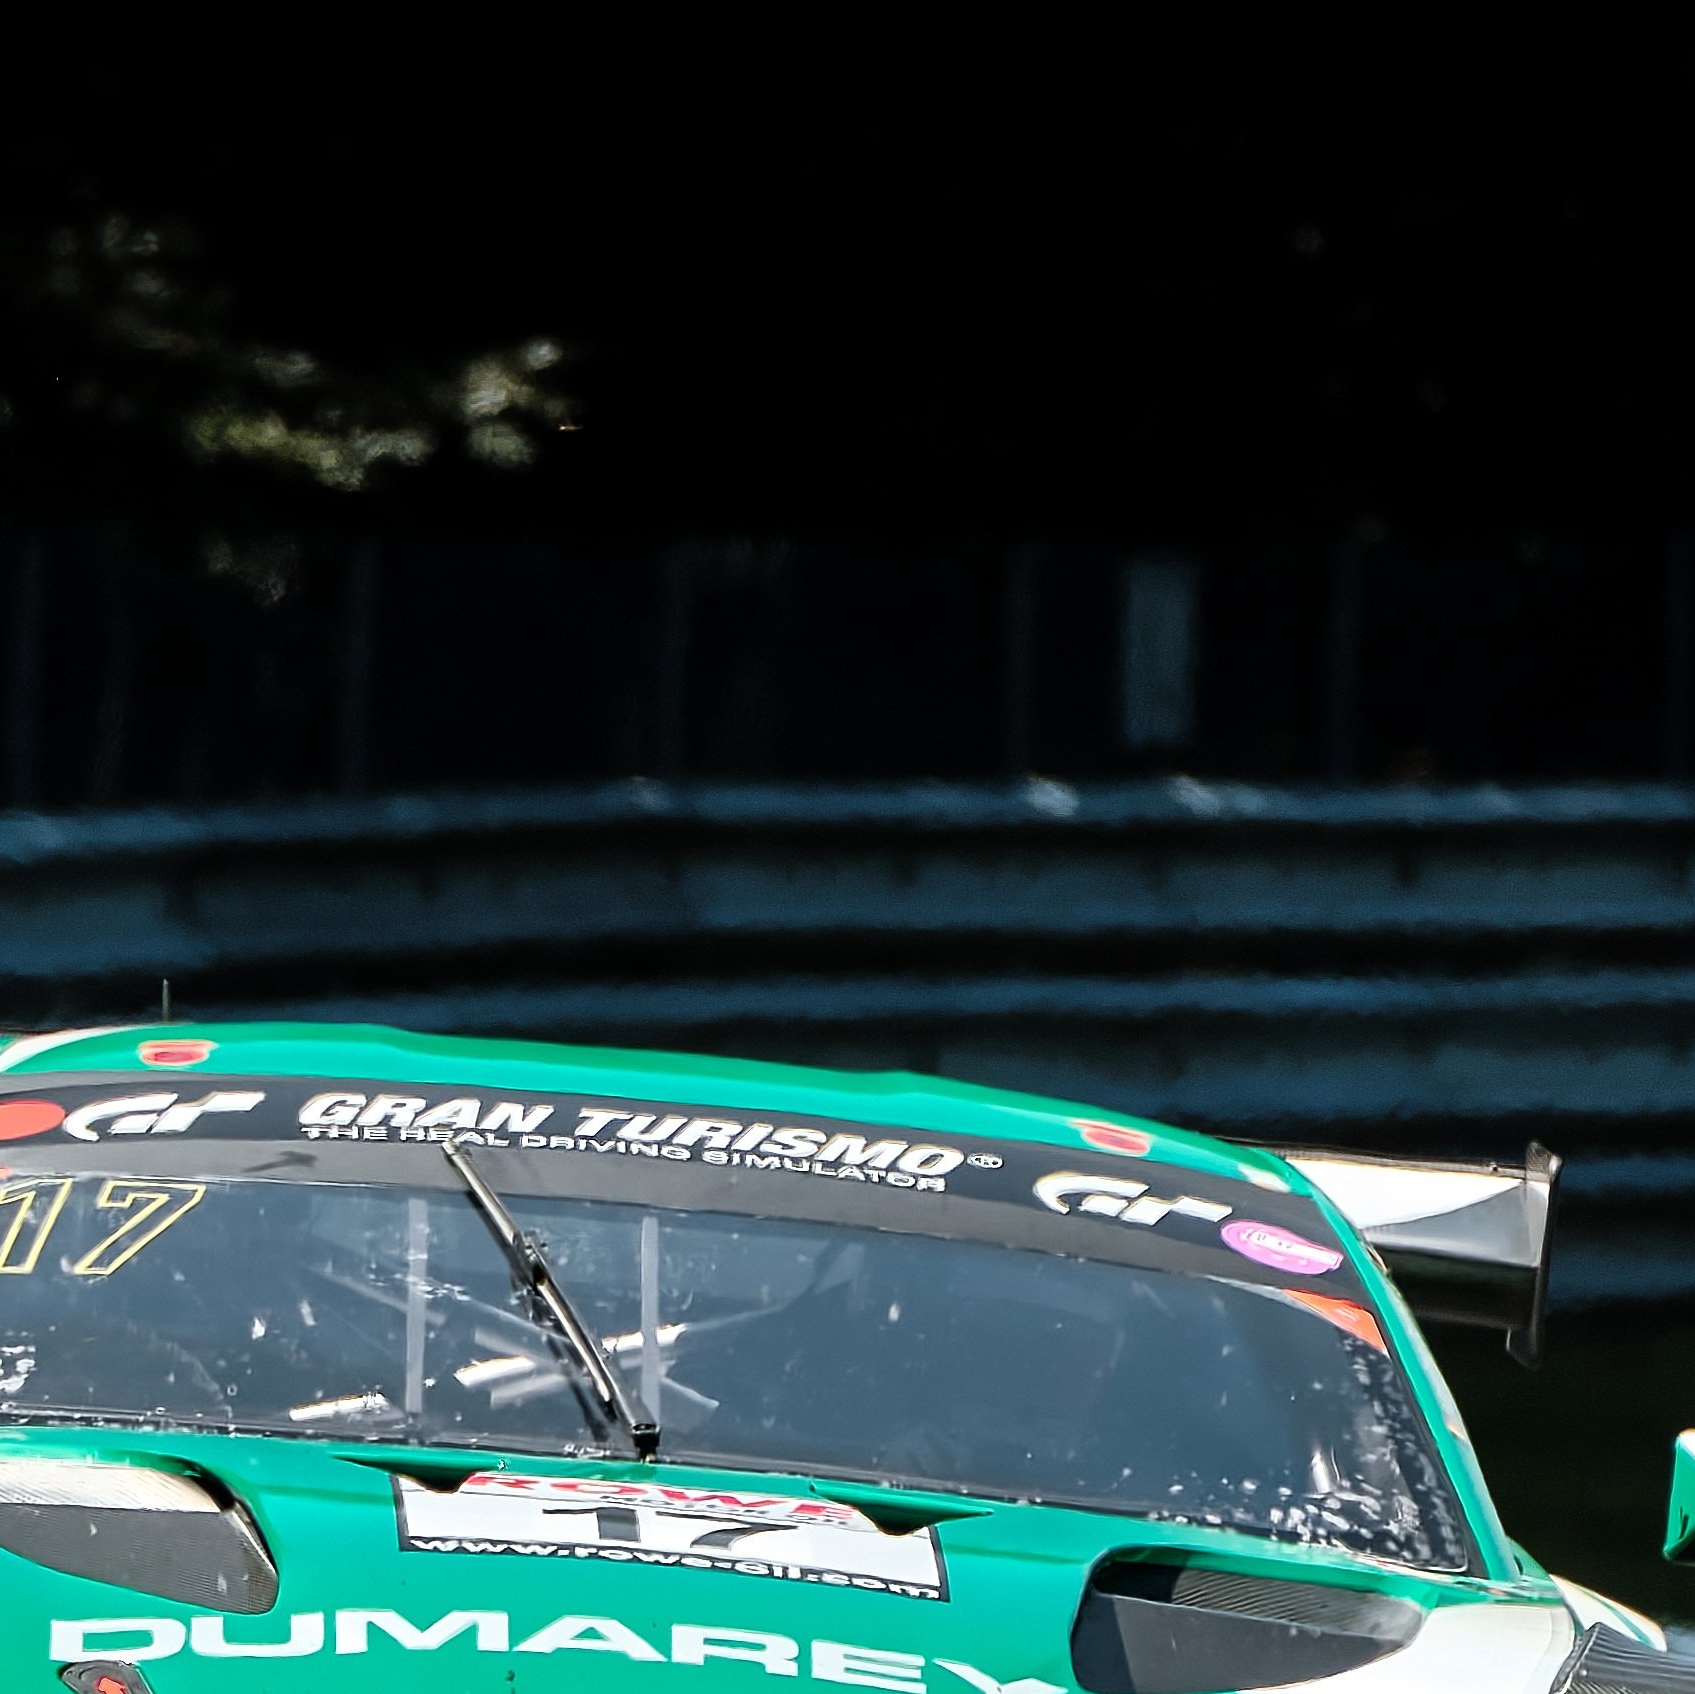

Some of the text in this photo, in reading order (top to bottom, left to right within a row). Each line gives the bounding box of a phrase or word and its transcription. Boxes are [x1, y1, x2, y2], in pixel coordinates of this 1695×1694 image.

[299, 1092, 555, 1133] GRAN
[301, 1126, 947, 1193] THE REAL DRIVING SIMULATOR
[466, 1475, 856, 1520] ROWE
[542, 1507, 799, 1552] 17
[410, 1539, 940, 1599] www.rowe-oil.com
